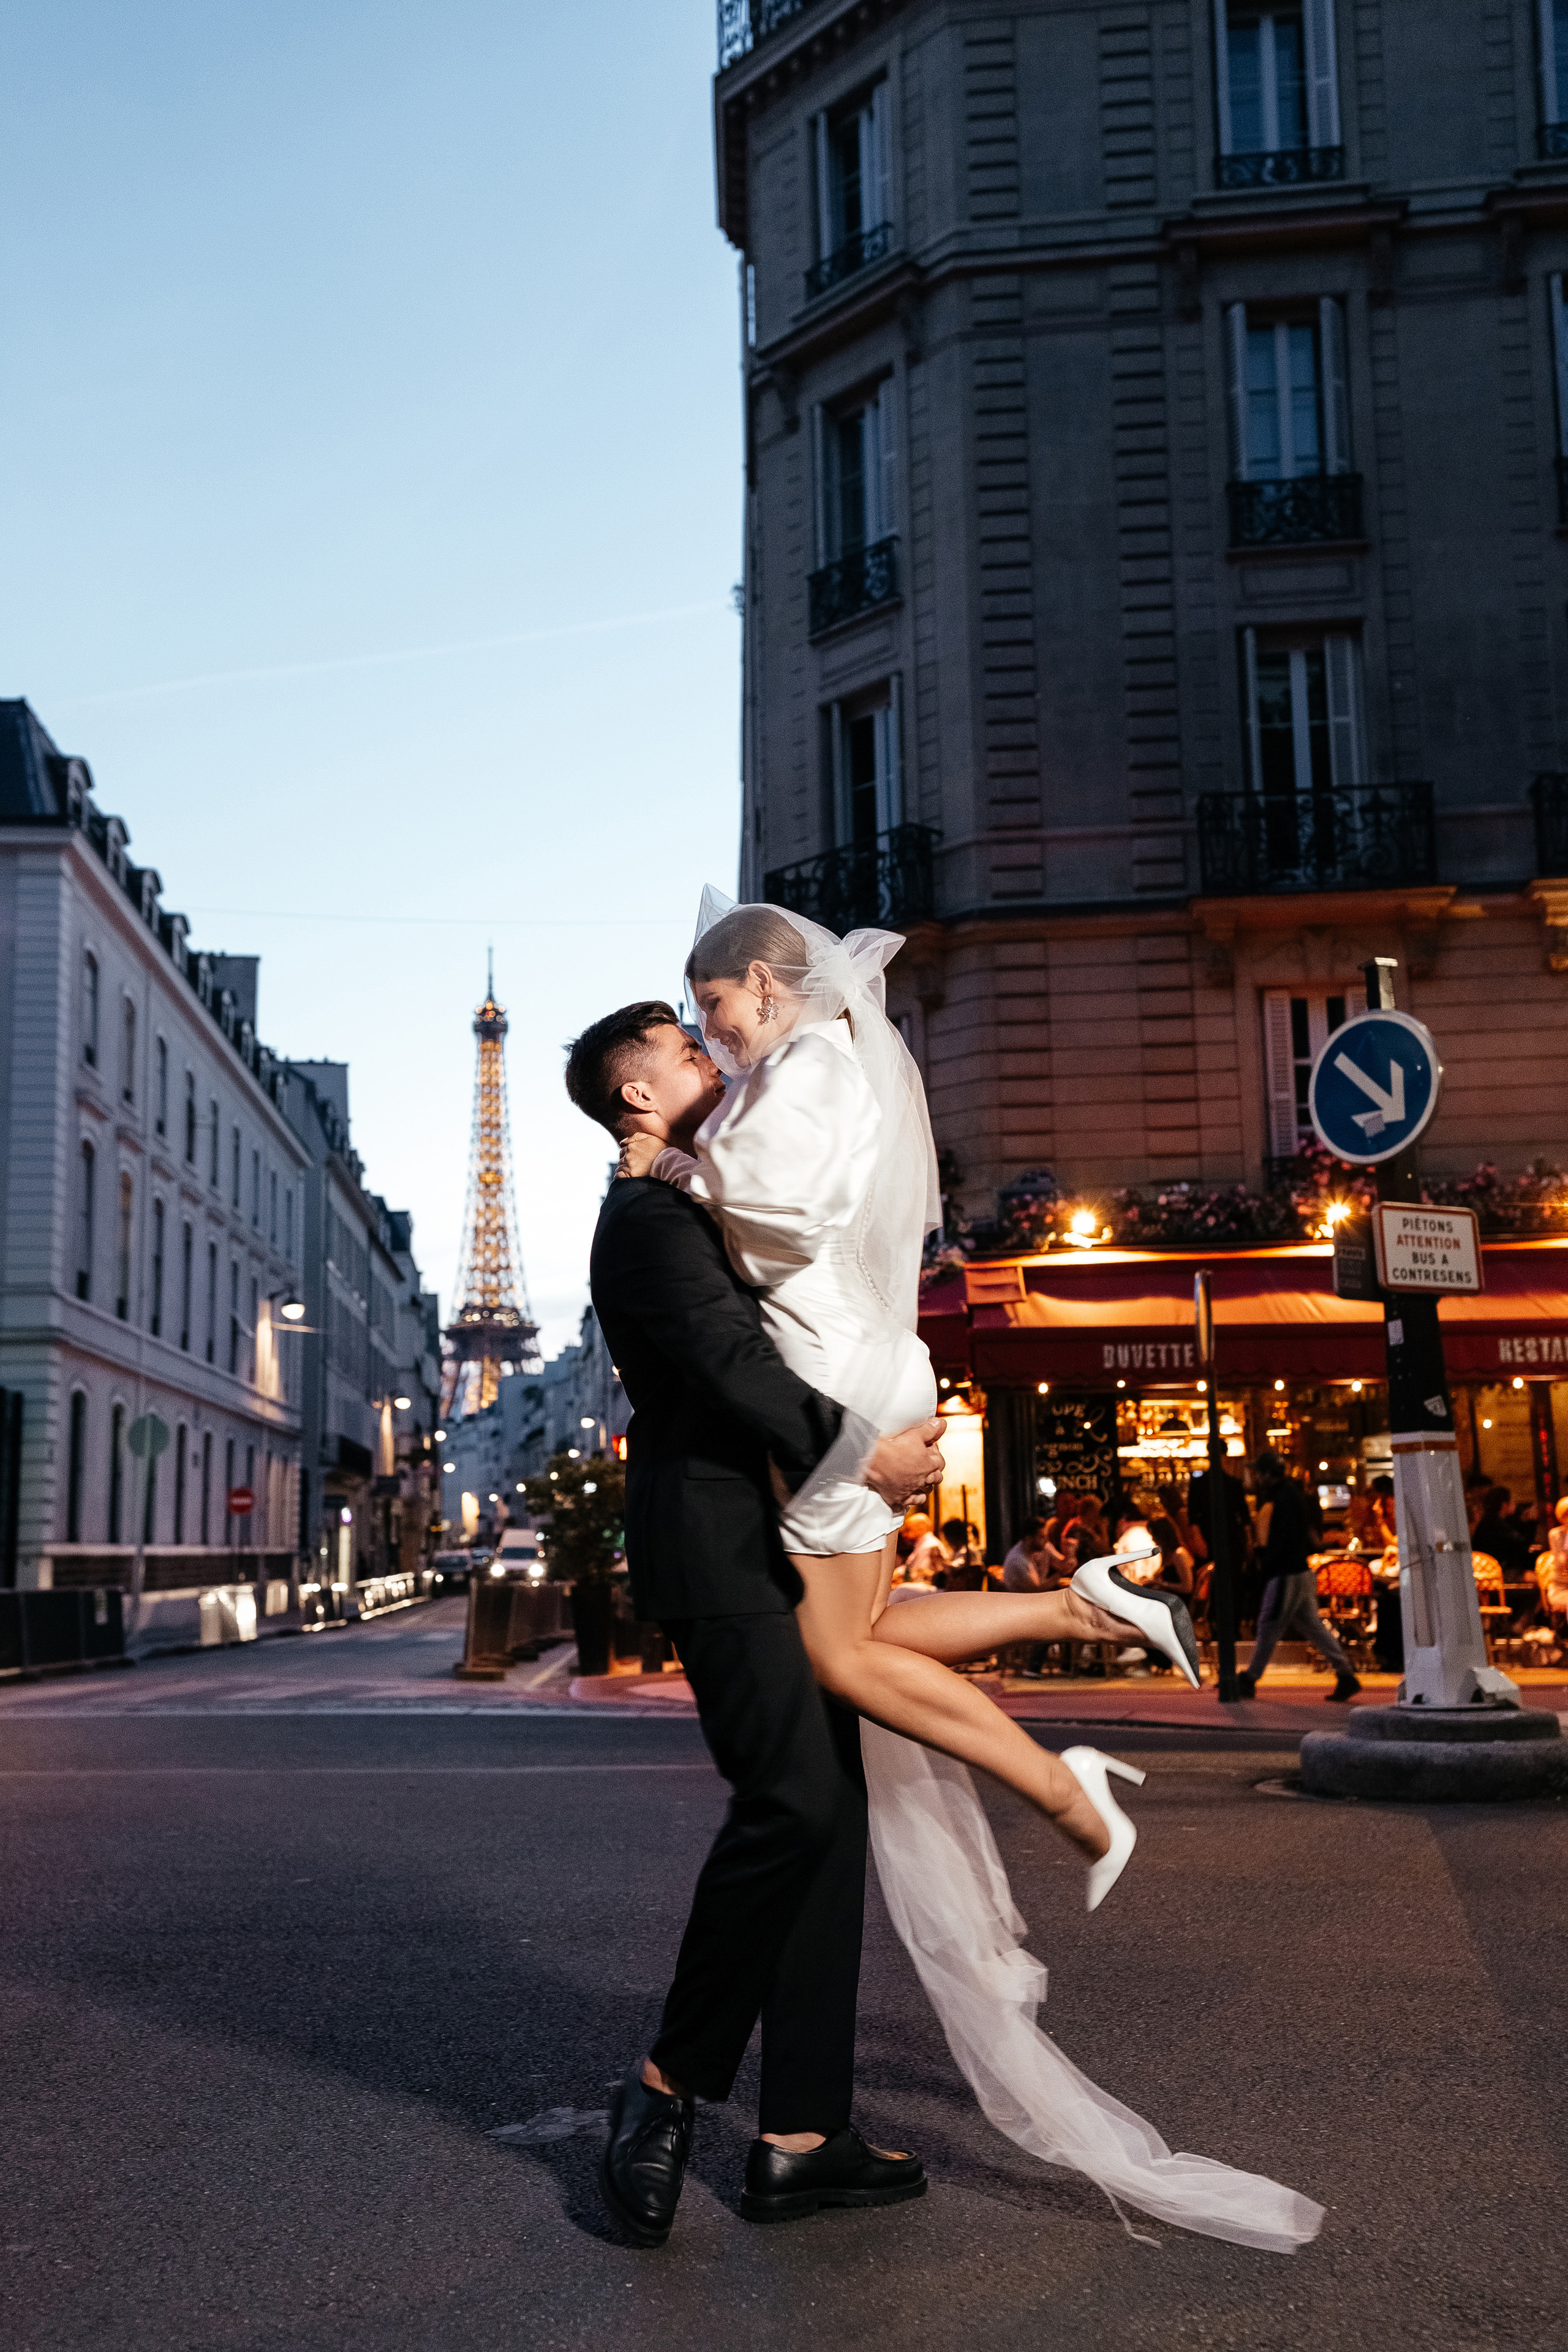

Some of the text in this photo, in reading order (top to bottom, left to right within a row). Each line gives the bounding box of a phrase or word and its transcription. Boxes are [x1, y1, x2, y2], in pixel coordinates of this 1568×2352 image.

[1396, 1234, 1461, 1250] ATTENTION
[1412, 1251, 1436, 1265] BUS
[1392, 1267, 1472, 1284] CONTRESENS
